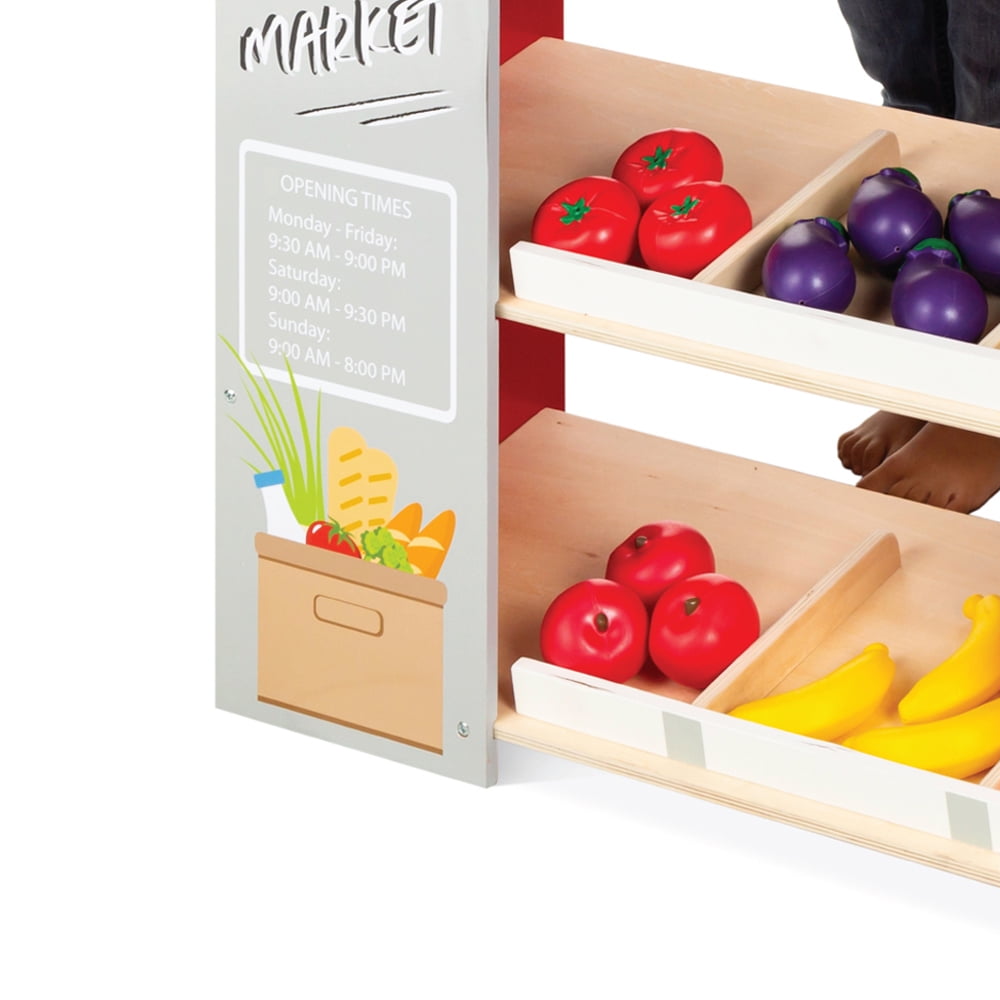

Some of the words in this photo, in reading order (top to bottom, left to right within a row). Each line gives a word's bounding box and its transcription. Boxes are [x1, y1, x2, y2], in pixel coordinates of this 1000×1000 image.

[280, 174, 358, 207] OPENING
[361, 192, 412, 219] TIMES
[268, 206, 332, 238] Monday
[345, 223, 397, 250] Friday:
[268, 233, 300, 254] 9:30
[304, 241, 330, 261] AM
[344, 251, 377, 272] 9:00
[381, 258, 406, 279] PM
[268, 259, 341, 291] Saturday:
[268, 285, 300, 307] 9:00
[304, 294, 330, 314] AM
[344, 304, 377, 325] 9:30
[381, 312, 406, 332] PM
[268, 311, 330, 341] Sunday:
[268, 338, 300, 360] 9:00
[304, 347, 330, 367] AM
[344, 356, 377, 379] 8:00
[381, 365, 406, 386] PM
